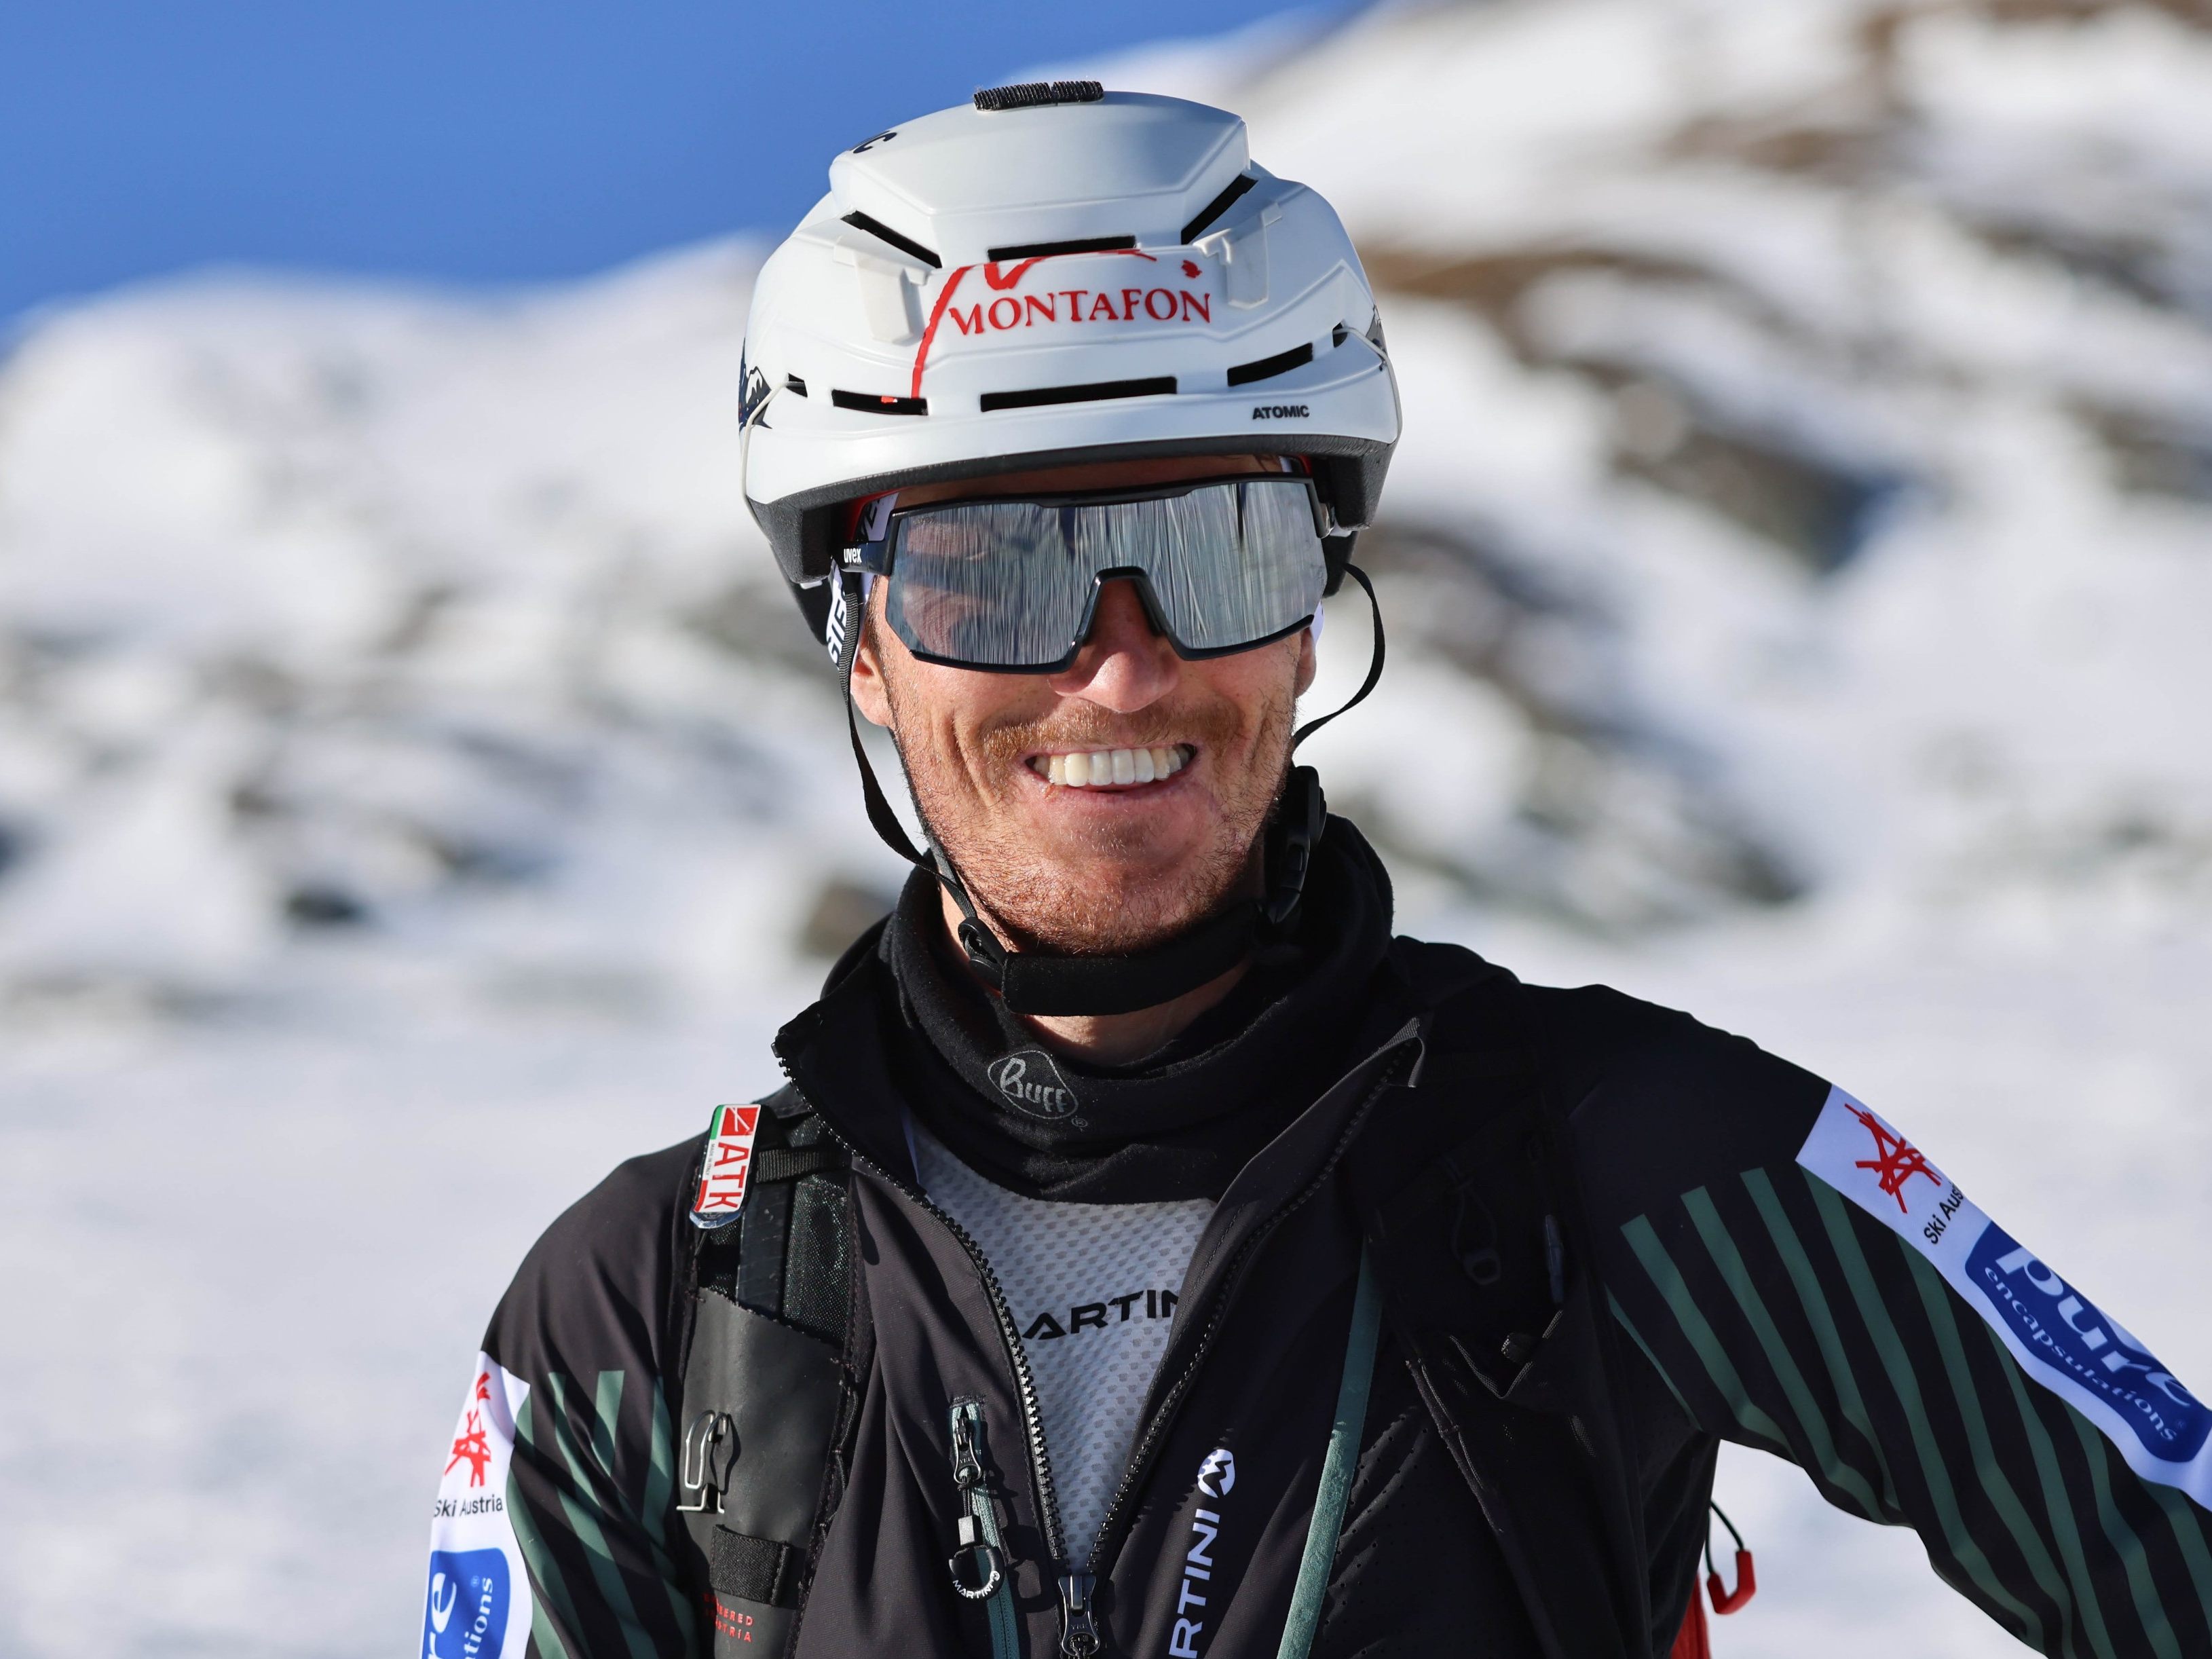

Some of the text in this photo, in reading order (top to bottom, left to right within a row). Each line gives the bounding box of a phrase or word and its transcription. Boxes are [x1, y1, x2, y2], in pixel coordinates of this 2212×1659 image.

[949, 288, 1210, 335] MONTAFON
[1252, 405, 1310, 420] ATOMIC
[843, 547, 862, 563] uvex
[705, 1142, 749, 1208] ATK
[1924, 1183, 1964, 1244] Ski Aus
[1995, 1246, 2191, 1407] pure
[1985, 1267, 2177, 1441] encapsulations
[434, 1493, 504, 1518] Ski Austria
[952, 1579, 994, 1599] MARTINI
[463, 1577, 493, 1659] tions
